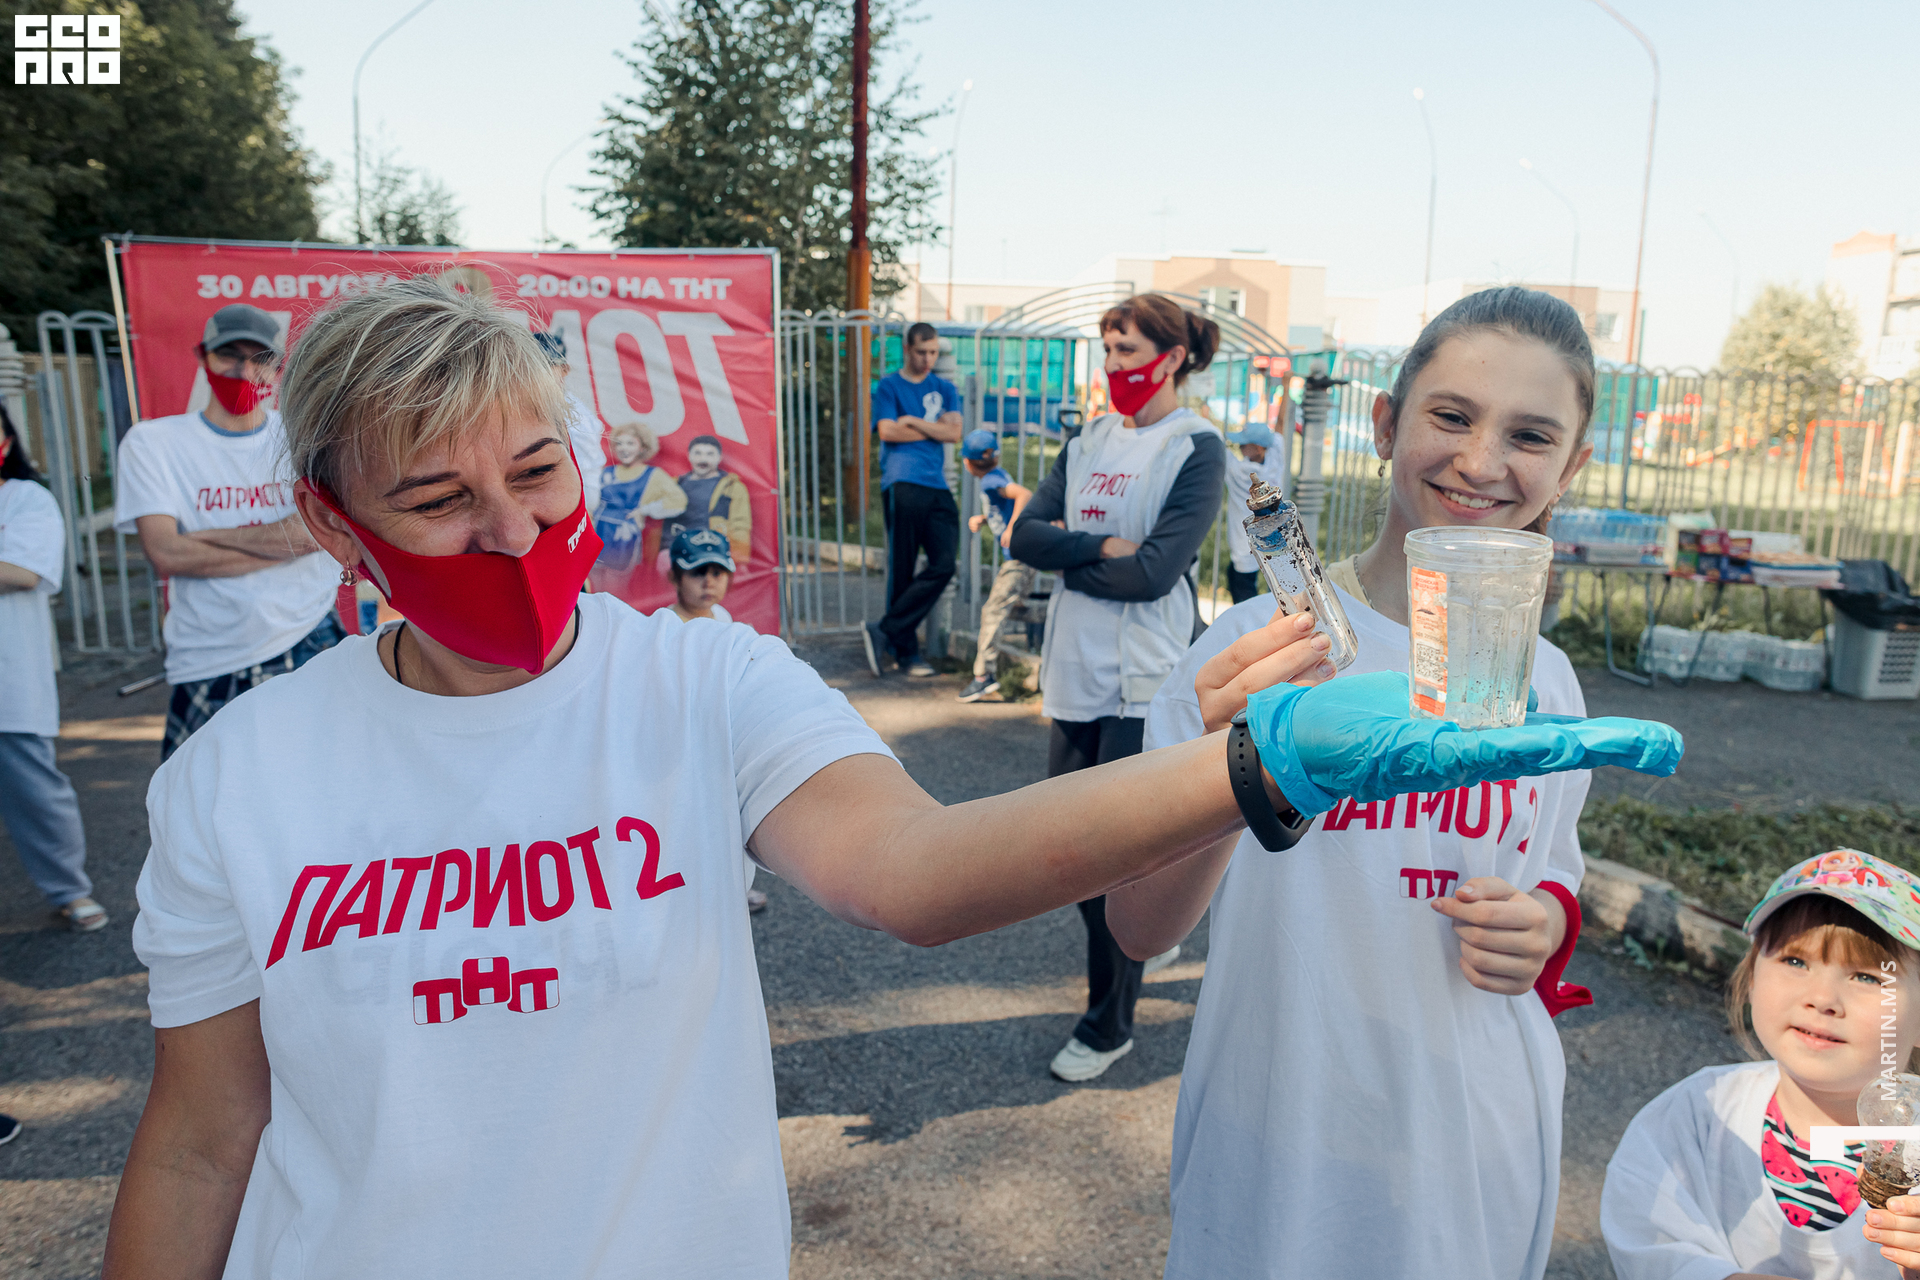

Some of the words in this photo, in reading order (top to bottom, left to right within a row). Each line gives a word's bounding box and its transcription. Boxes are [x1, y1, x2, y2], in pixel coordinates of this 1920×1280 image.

[197, 275, 243, 298] 30
[517, 274, 611, 298] 20:00
[617, 277, 665, 299] НА
[668, 278, 733, 300] ТНТ
[265, 826, 612, 971] ПАТРИОТ
[616, 816, 686, 900] 2
[413, 956, 560, 1025] ТНТ
